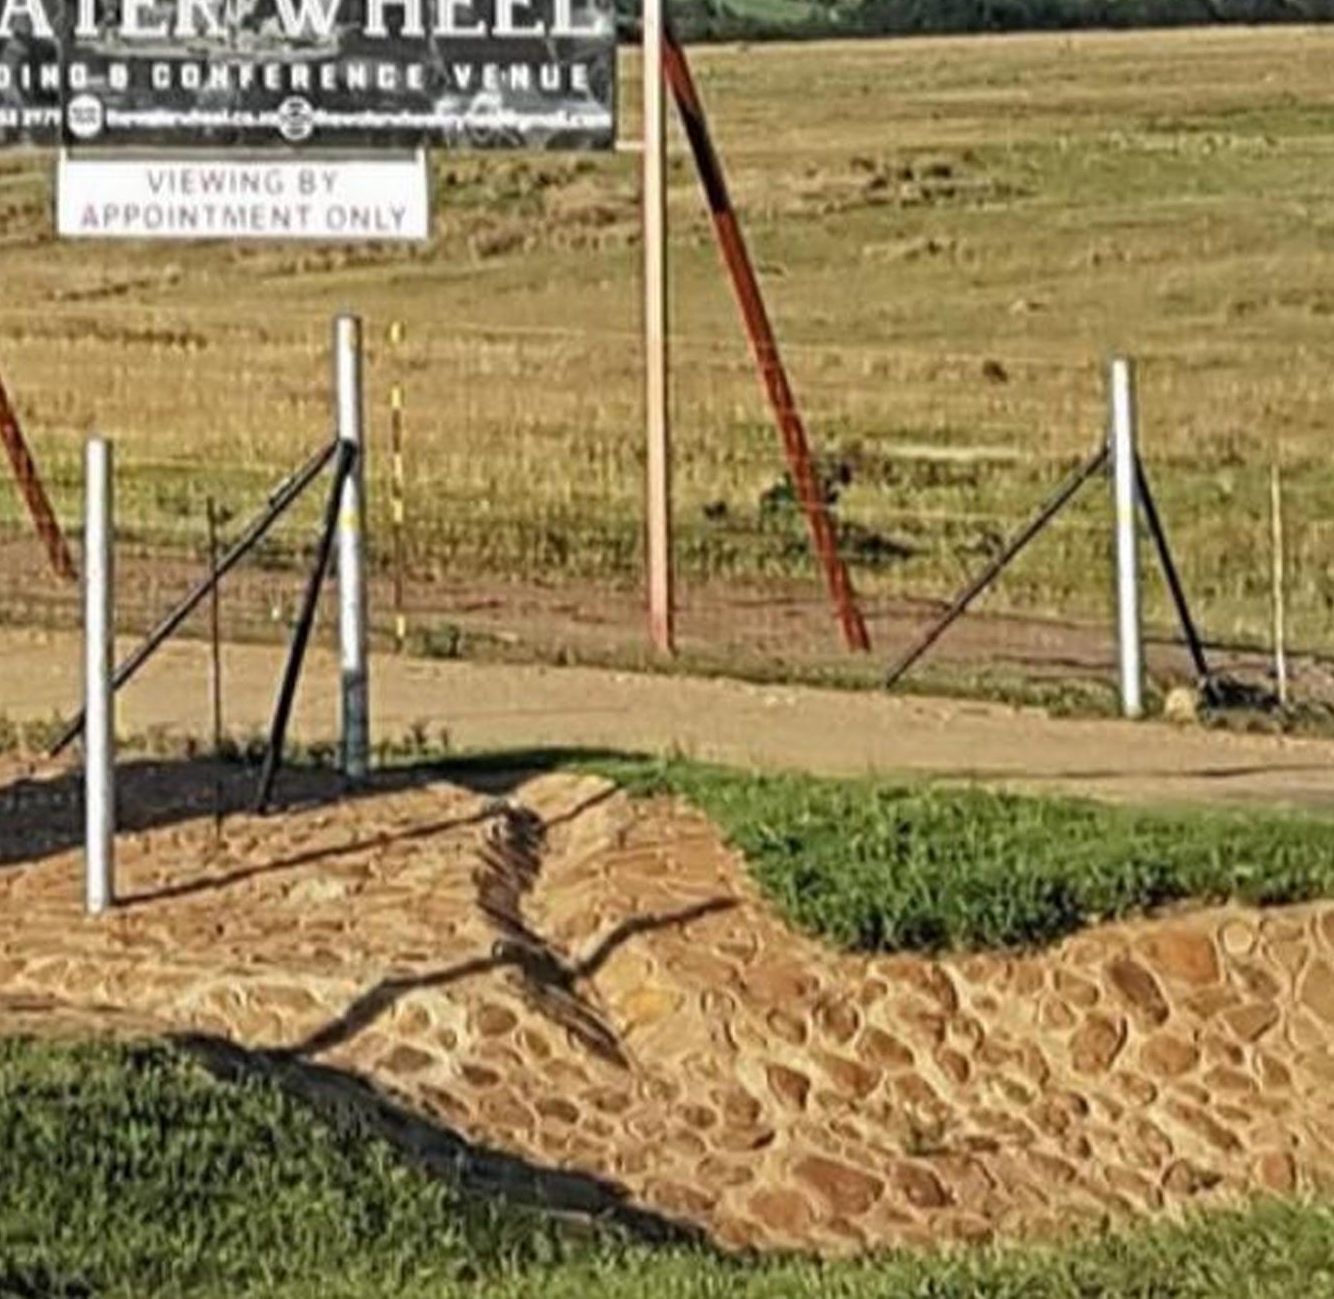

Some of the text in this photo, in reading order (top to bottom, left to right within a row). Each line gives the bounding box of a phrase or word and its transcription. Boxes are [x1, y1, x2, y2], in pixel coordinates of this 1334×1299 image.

[152, 61, 423, 91] CONFERENCE
[453, 62, 588, 90] VENUE
[146, 168, 339, 196] VIEWING BY
[80, 202, 407, 230] APPOINTMENT ONLY
